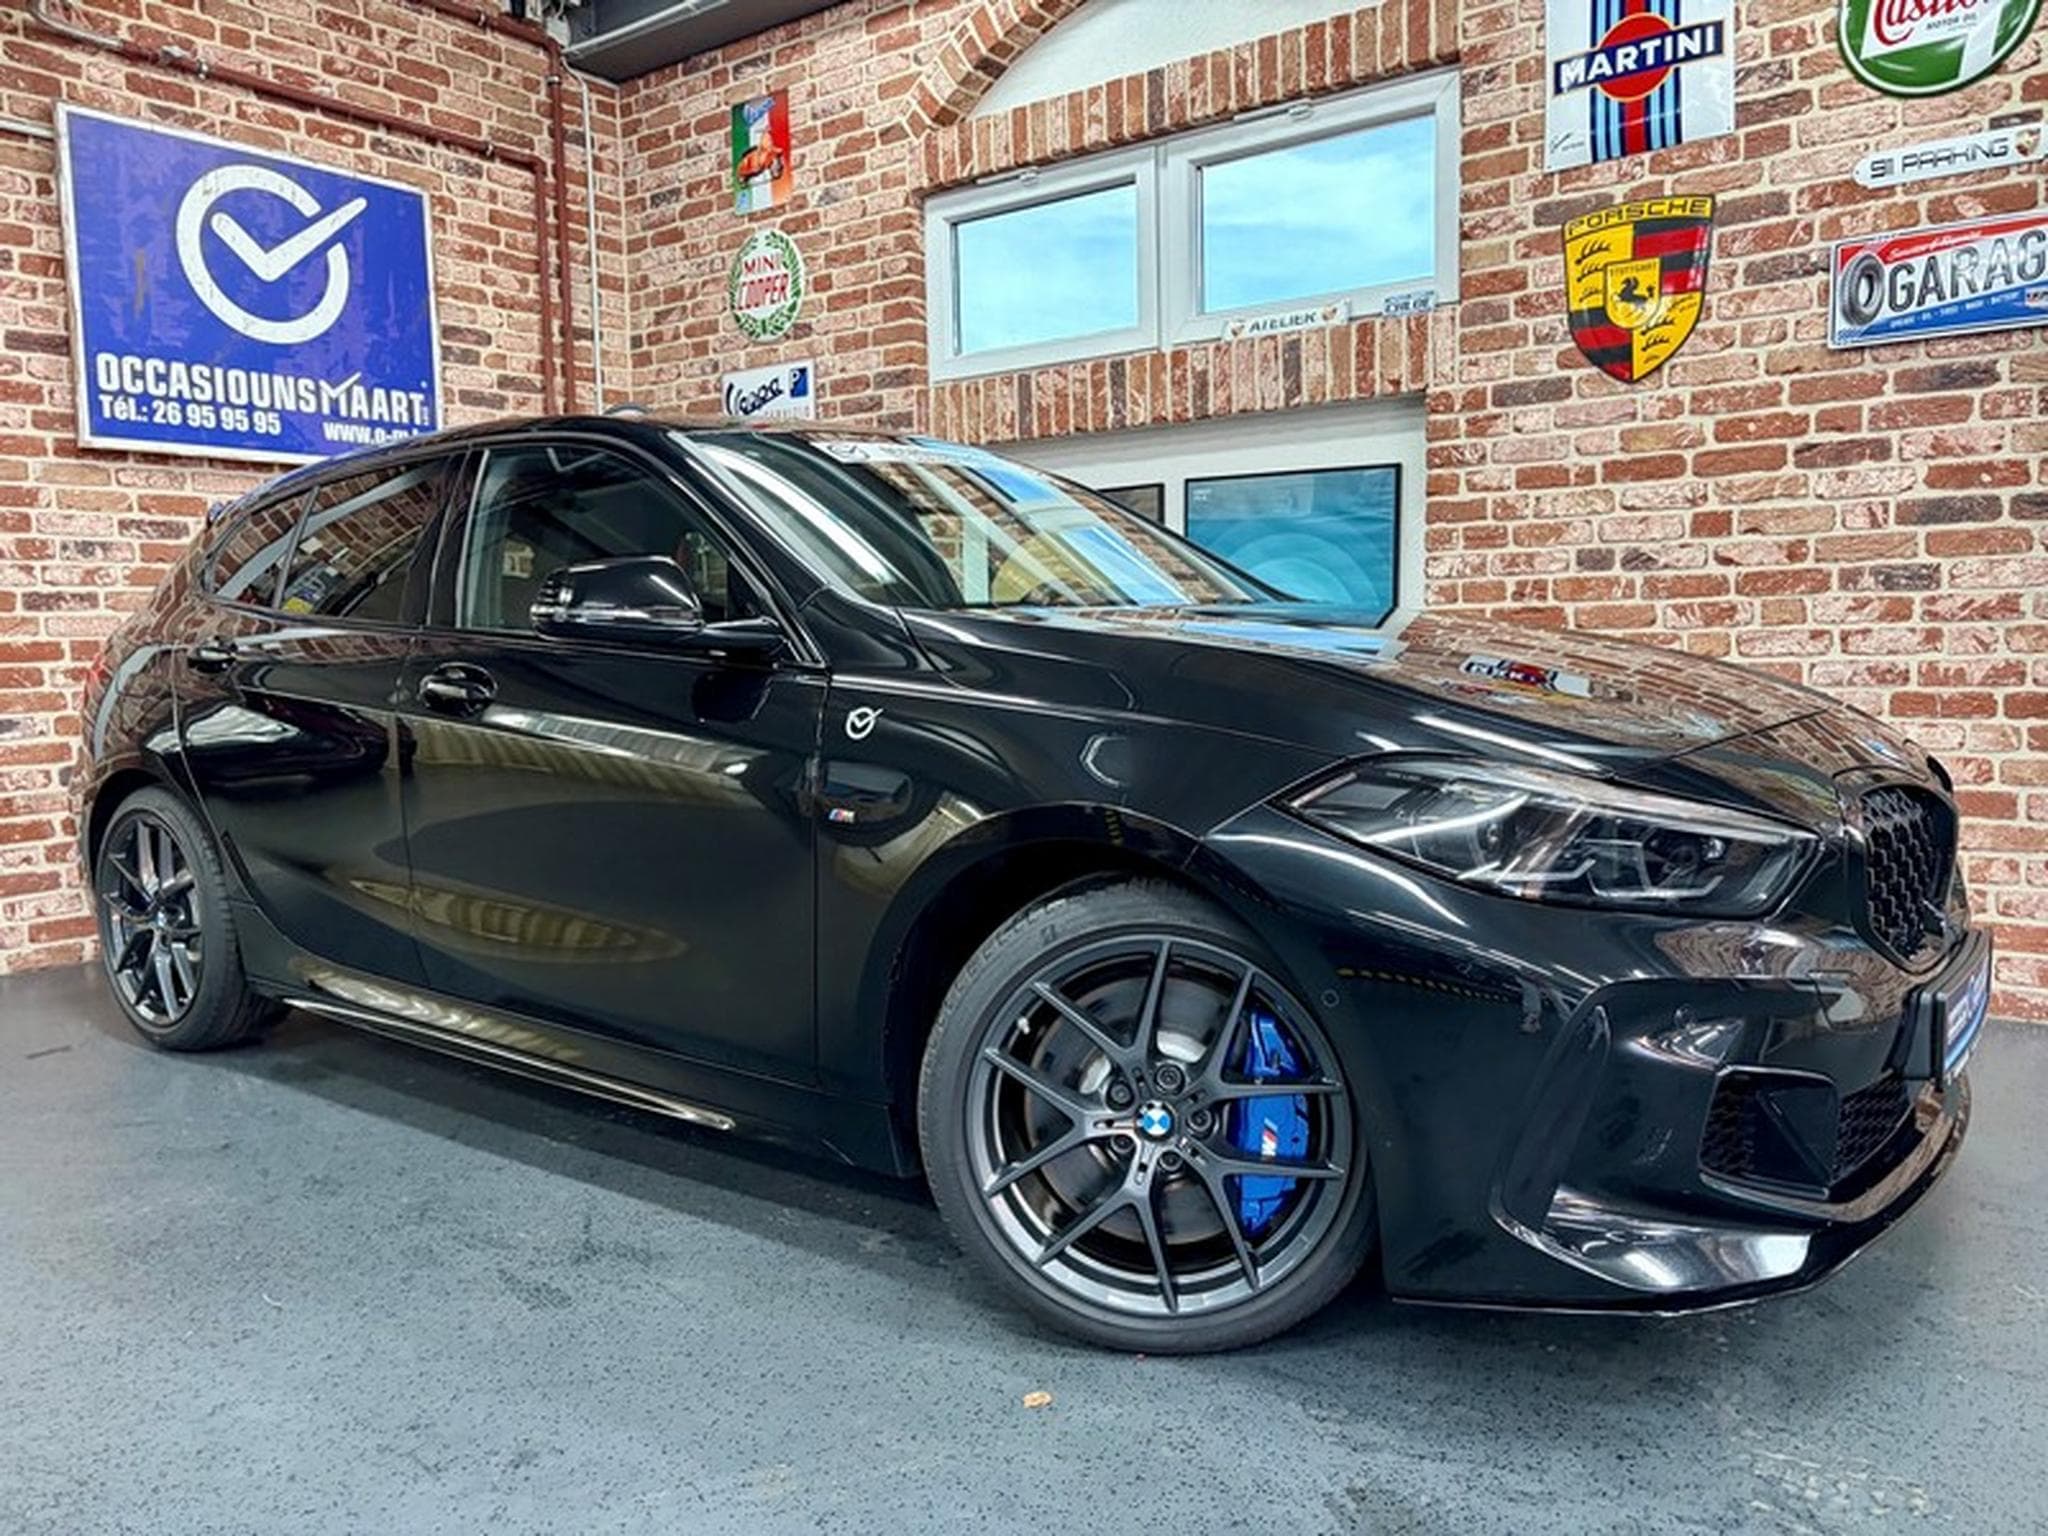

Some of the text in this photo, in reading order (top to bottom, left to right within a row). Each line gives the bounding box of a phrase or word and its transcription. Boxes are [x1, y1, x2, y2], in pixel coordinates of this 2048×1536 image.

[1560, 25, 1715, 89] MARTINI
[1902, 137, 2009, 174] PARKING
[1567, 199, 1709, 236] PORSCHE
[743, 252, 782, 275] MINI
[736, 273, 790, 311] COOPER
[1248, 309, 1318, 333] ATELIER
[98, 393, 282, 436] Tél.: 26 95 95 95
